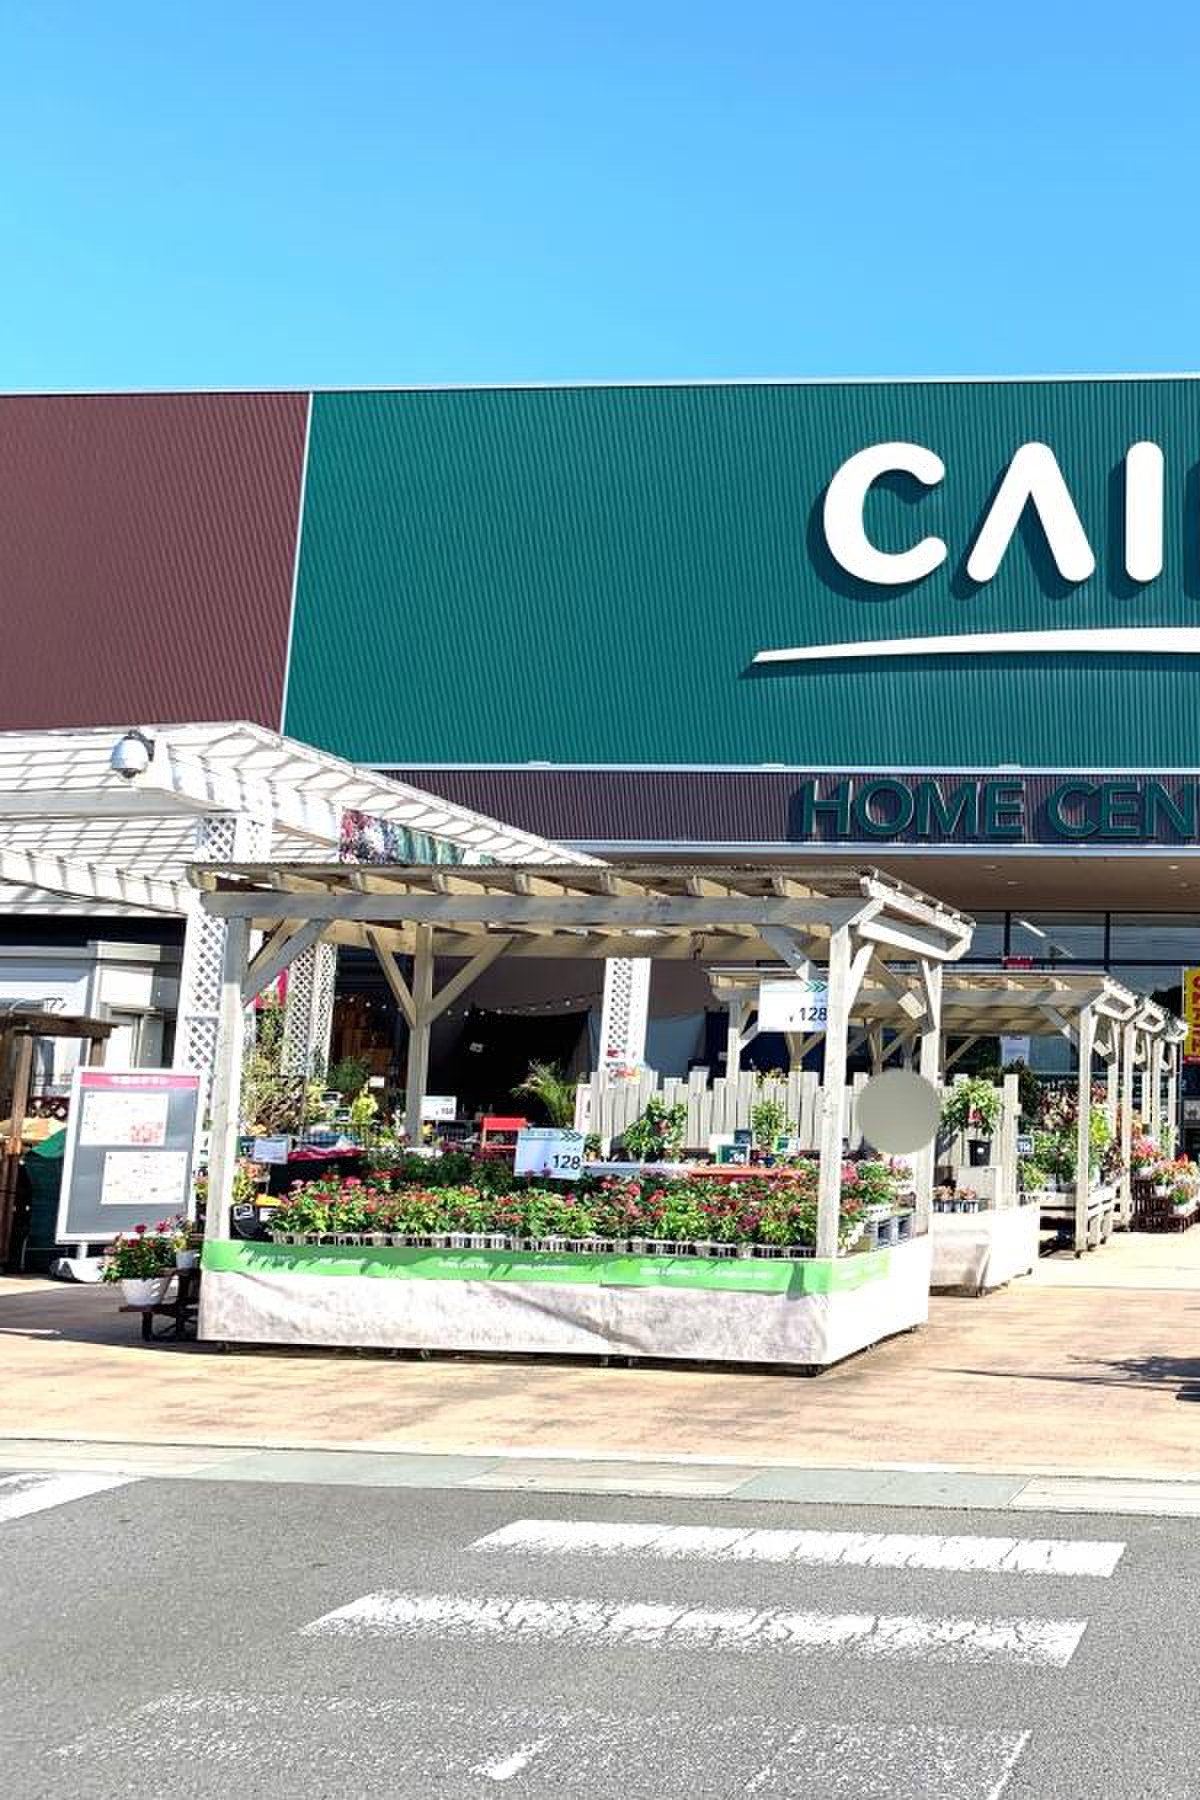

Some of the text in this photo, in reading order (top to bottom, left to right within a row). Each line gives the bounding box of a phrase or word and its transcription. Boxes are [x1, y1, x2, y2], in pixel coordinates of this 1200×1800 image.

[801, 778, 1025, 838] HOME
[799, 1007, 828, 1021] 128
[553, 1154, 581, 1170] 128
